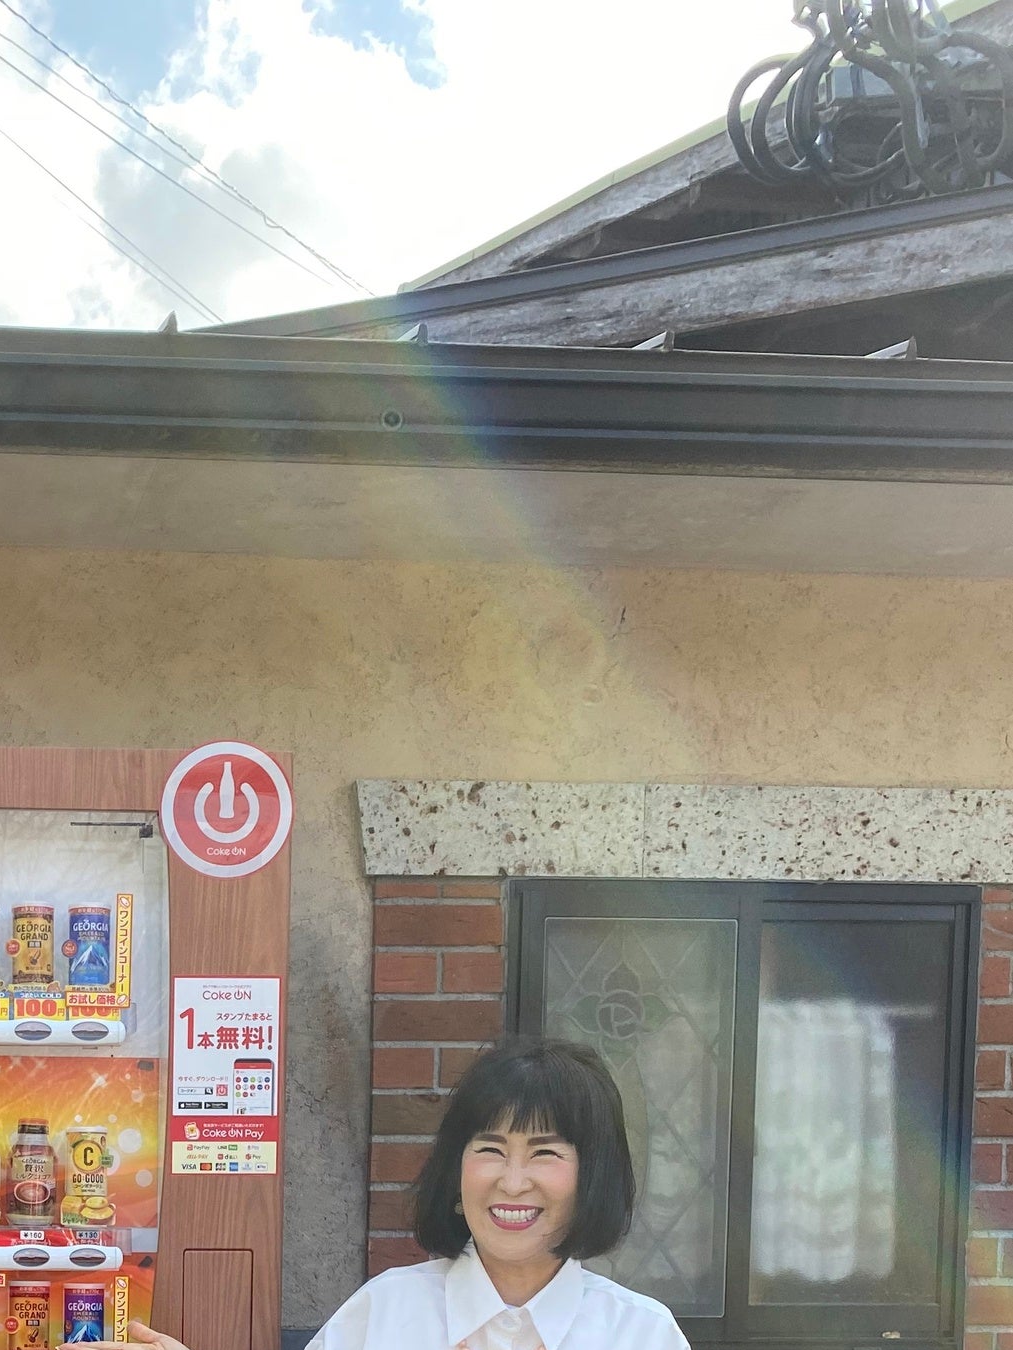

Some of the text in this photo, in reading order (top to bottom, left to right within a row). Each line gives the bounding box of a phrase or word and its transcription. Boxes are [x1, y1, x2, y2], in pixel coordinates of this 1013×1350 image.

[206, 847, 246, 856] Coke ON
[119, 910, 128, 992] ワンコインコーナー
[68, 995, 115, 1005] お試し価格
[203, 989, 252, 1000] Coke ON
[17, 999, 65, 1016] 100円
[216, 1012, 273, 1021] スタンプたまると
[179, 1008, 273, 1050] 1本無料!
[202, 1128, 264, 1140] Coke ON Pay
[83, 1147, 94, 1167] C
[15, 1303, 50, 1311] GEORGIA
[68, 1302, 103, 1311] GEORGIA
[19, 1311, 46, 1319] GRAND
[116, 1291, 126, 1343] ワンコインコ
